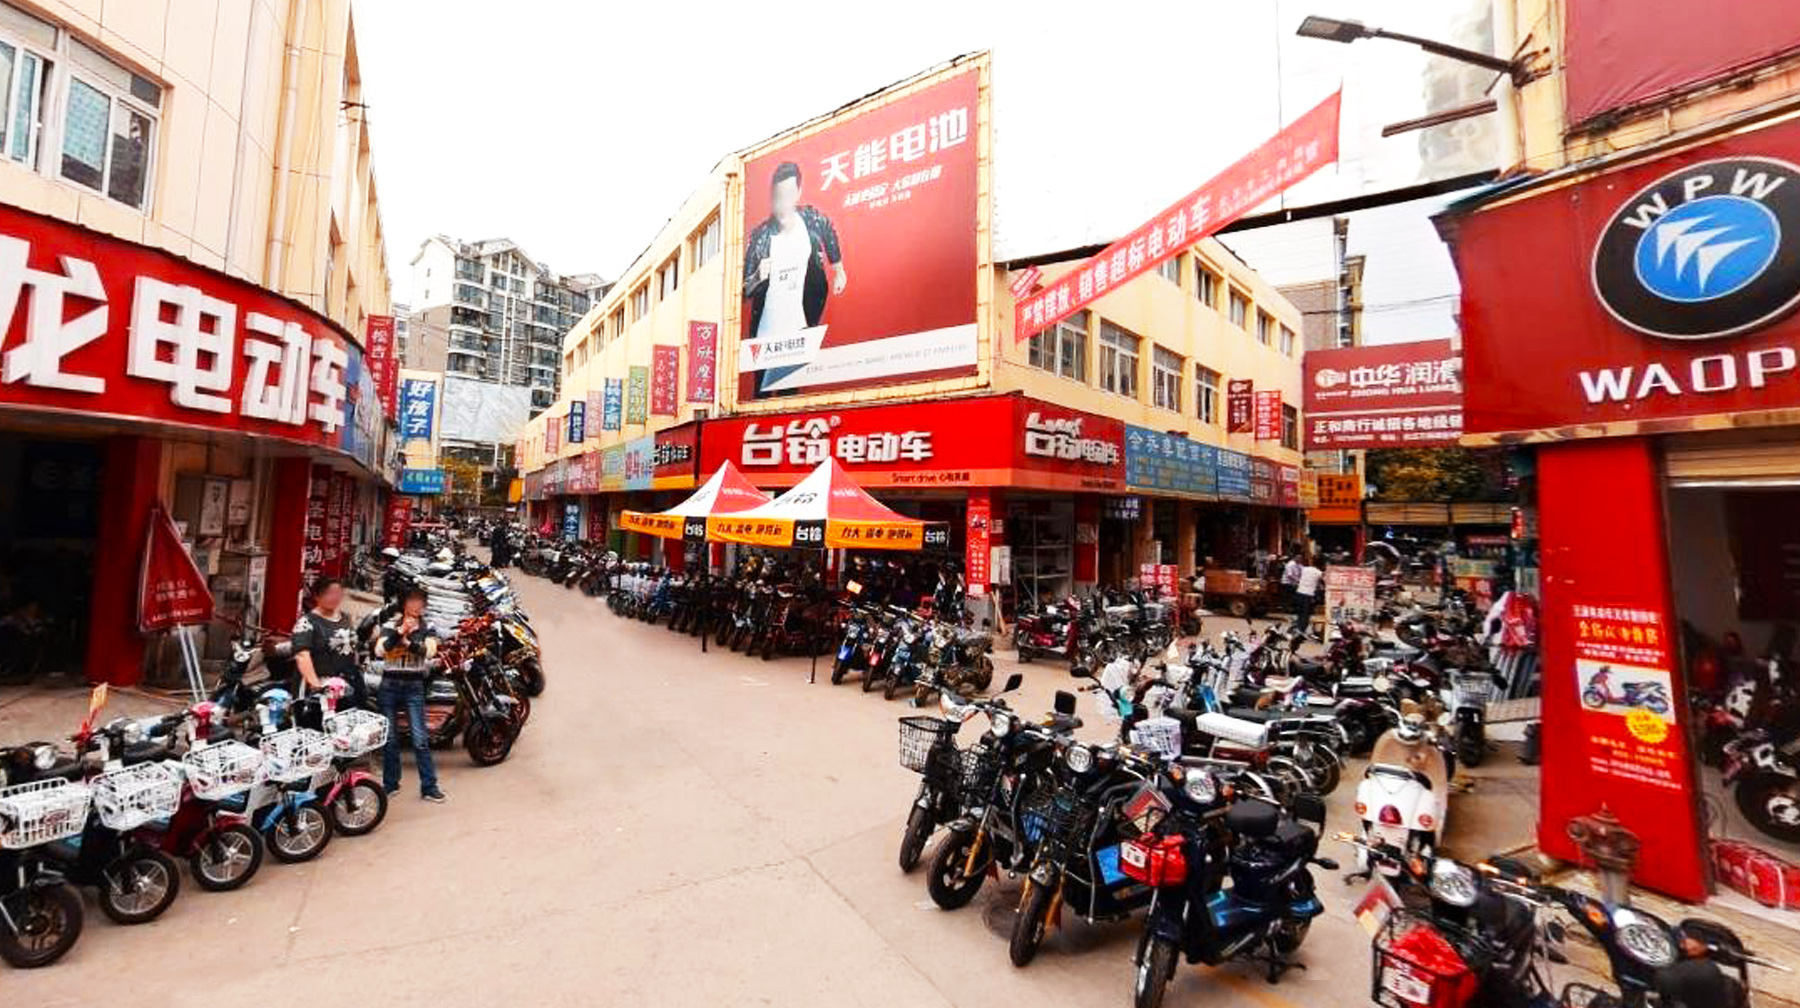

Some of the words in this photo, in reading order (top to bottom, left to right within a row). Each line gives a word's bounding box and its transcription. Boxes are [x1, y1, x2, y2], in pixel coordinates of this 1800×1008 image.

[820, 107, 968, 191] 天能电池
[1622, 168, 1786, 231] WPW
[0, 234, 346, 434] 龙电动车
[1579, 347, 1796, 404] WAOP
[406, 380, 433, 434] 好孩子
[1025, 412, 1120, 465] 台铃电动车
[796, 525, 821, 541] 台铃
